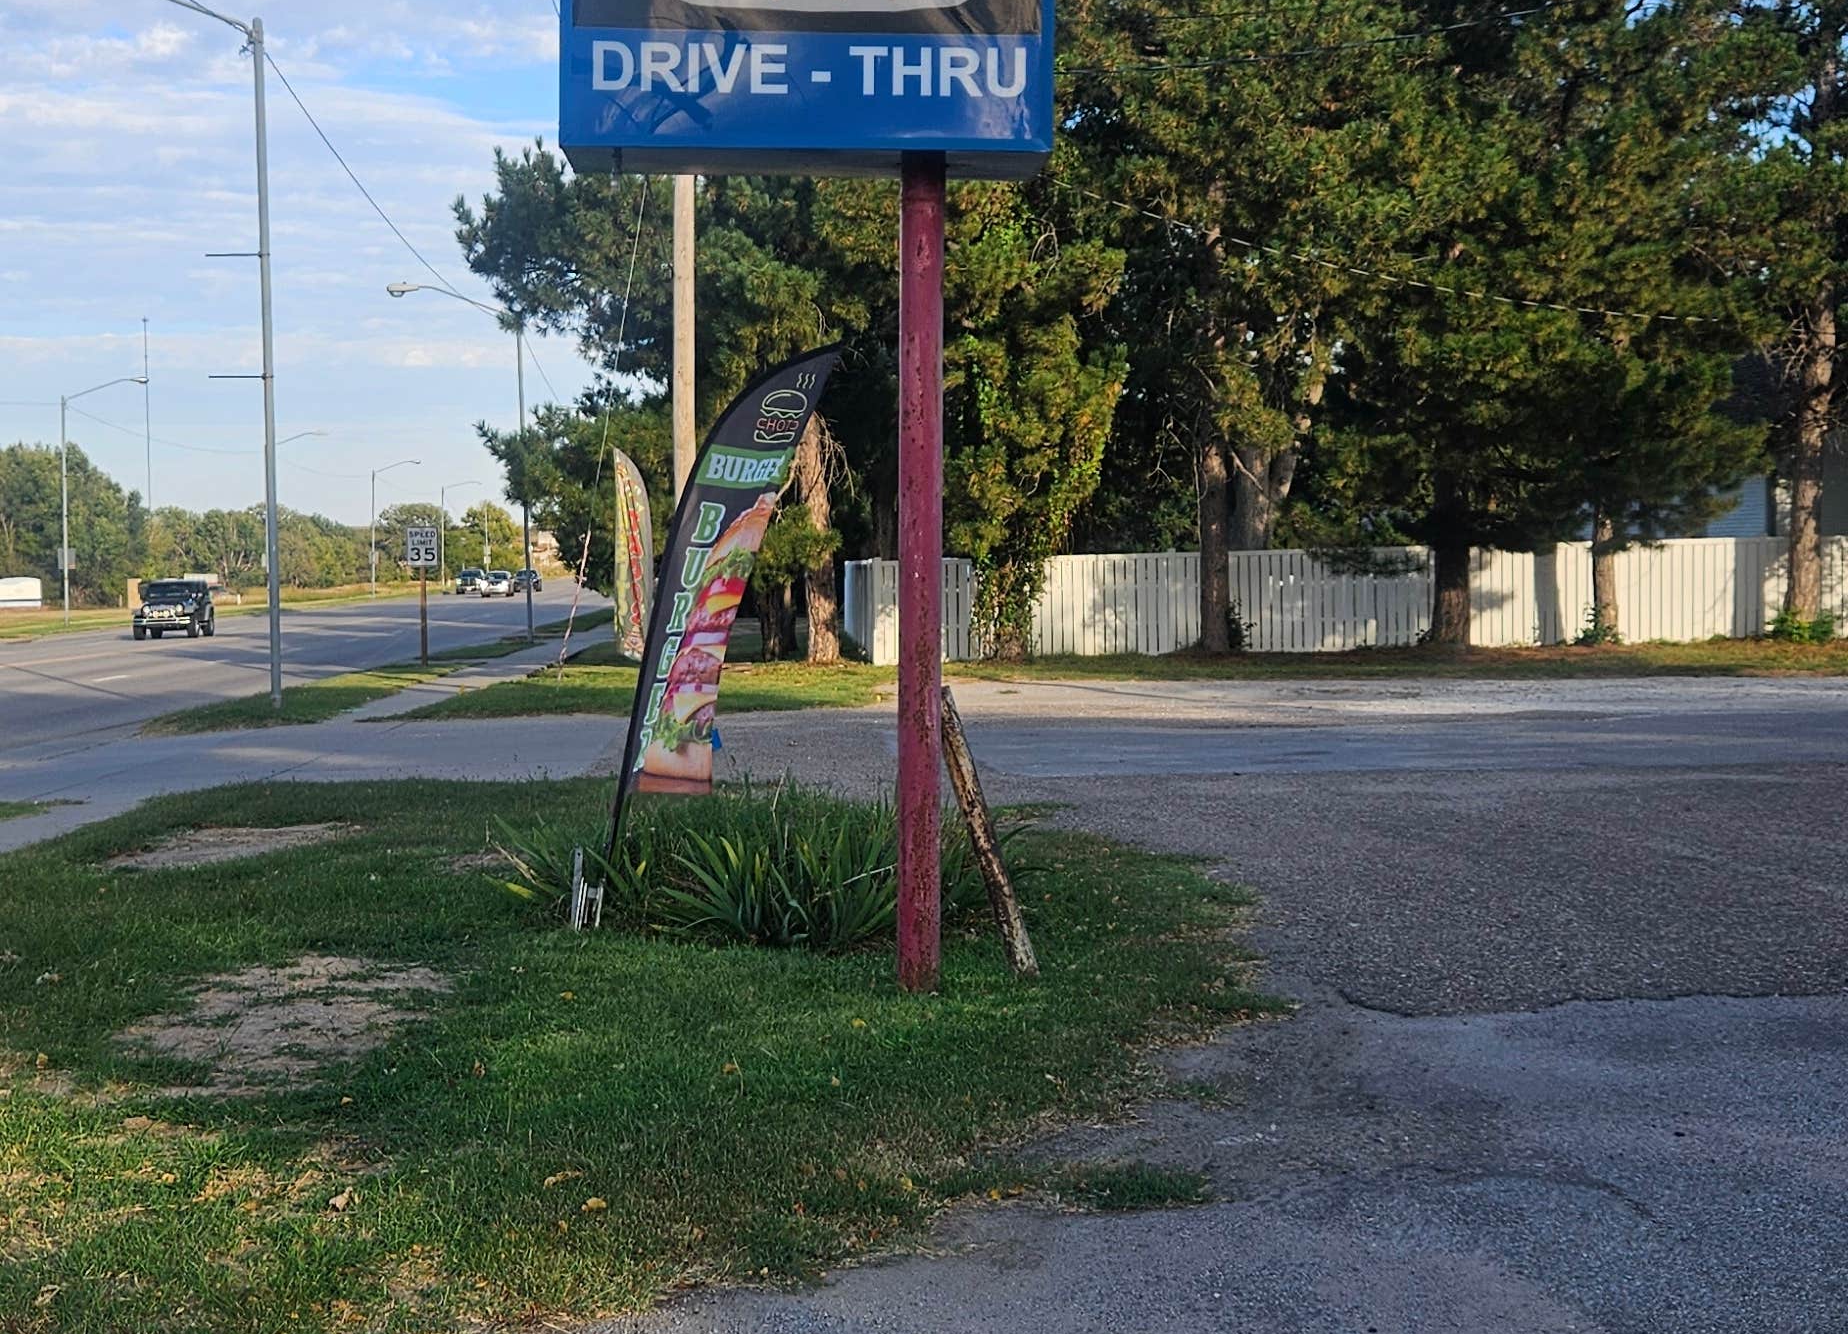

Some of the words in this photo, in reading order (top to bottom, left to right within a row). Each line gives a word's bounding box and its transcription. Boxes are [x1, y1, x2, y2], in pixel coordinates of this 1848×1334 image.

[592, 40, 789, 95] DRIVE
[849, 45, 1027, 98] THRU
[409, 530, 436, 538] SPEED
[410, 547, 436, 561] 35
